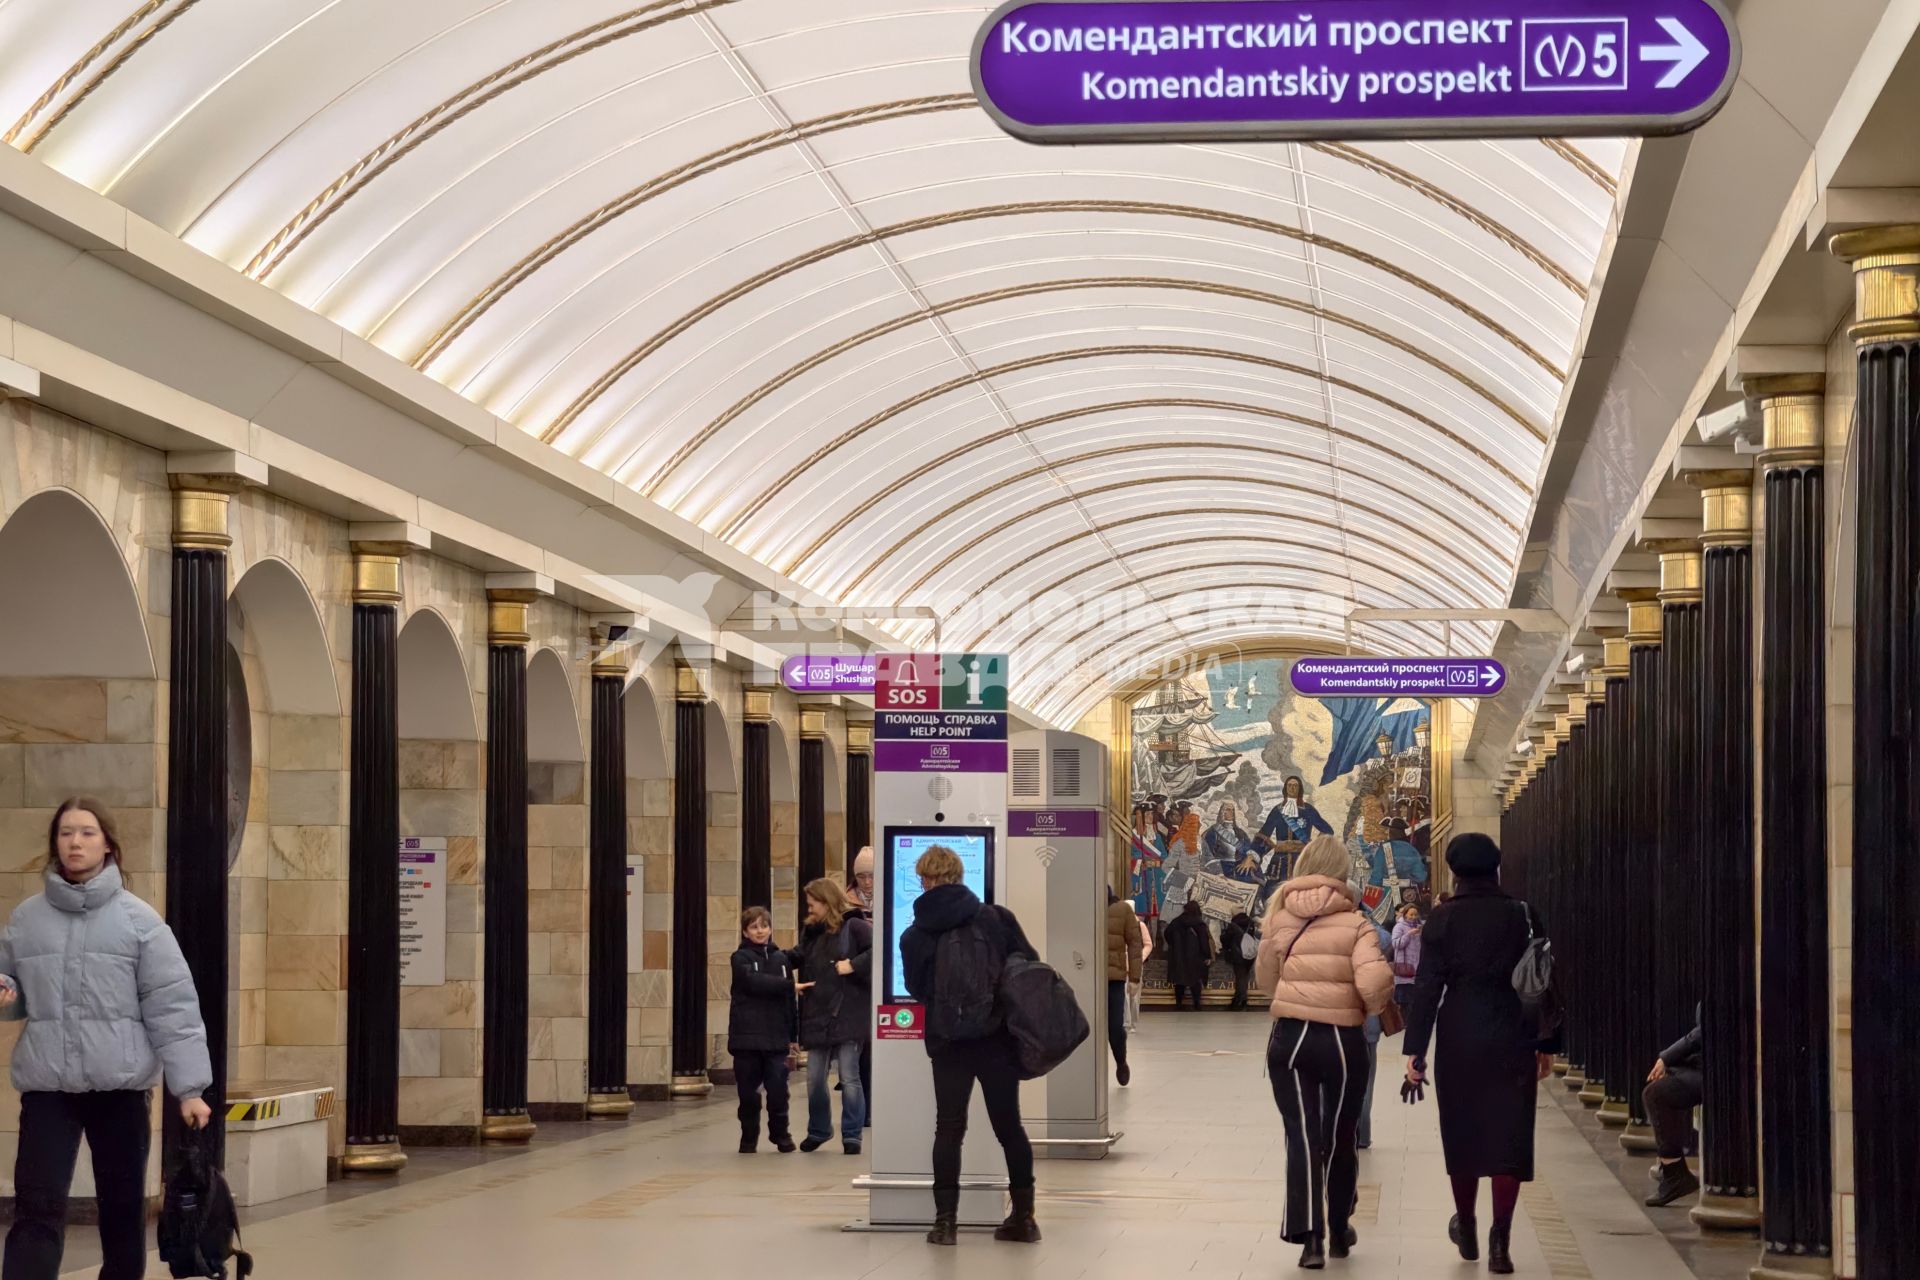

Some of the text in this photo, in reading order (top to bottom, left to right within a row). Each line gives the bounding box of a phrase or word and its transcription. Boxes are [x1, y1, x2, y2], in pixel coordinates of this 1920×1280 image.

[1002, 15, 1513, 54] Комендантский проспект
[1082, 63, 1512, 102] Komendantskiy prospekt
[835, 663, 876, 674] Шушар
[1296, 661, 1445, 675] Комендантский проспект
[1320, 677, 1445, 690] Komendantskiy prospekt
[888, 689, 927, 704] SOS
[885, 714, 997, 725] ПОМОЩЬ СПРАВКА
[910, 727, 972, 737] HELP POINT
